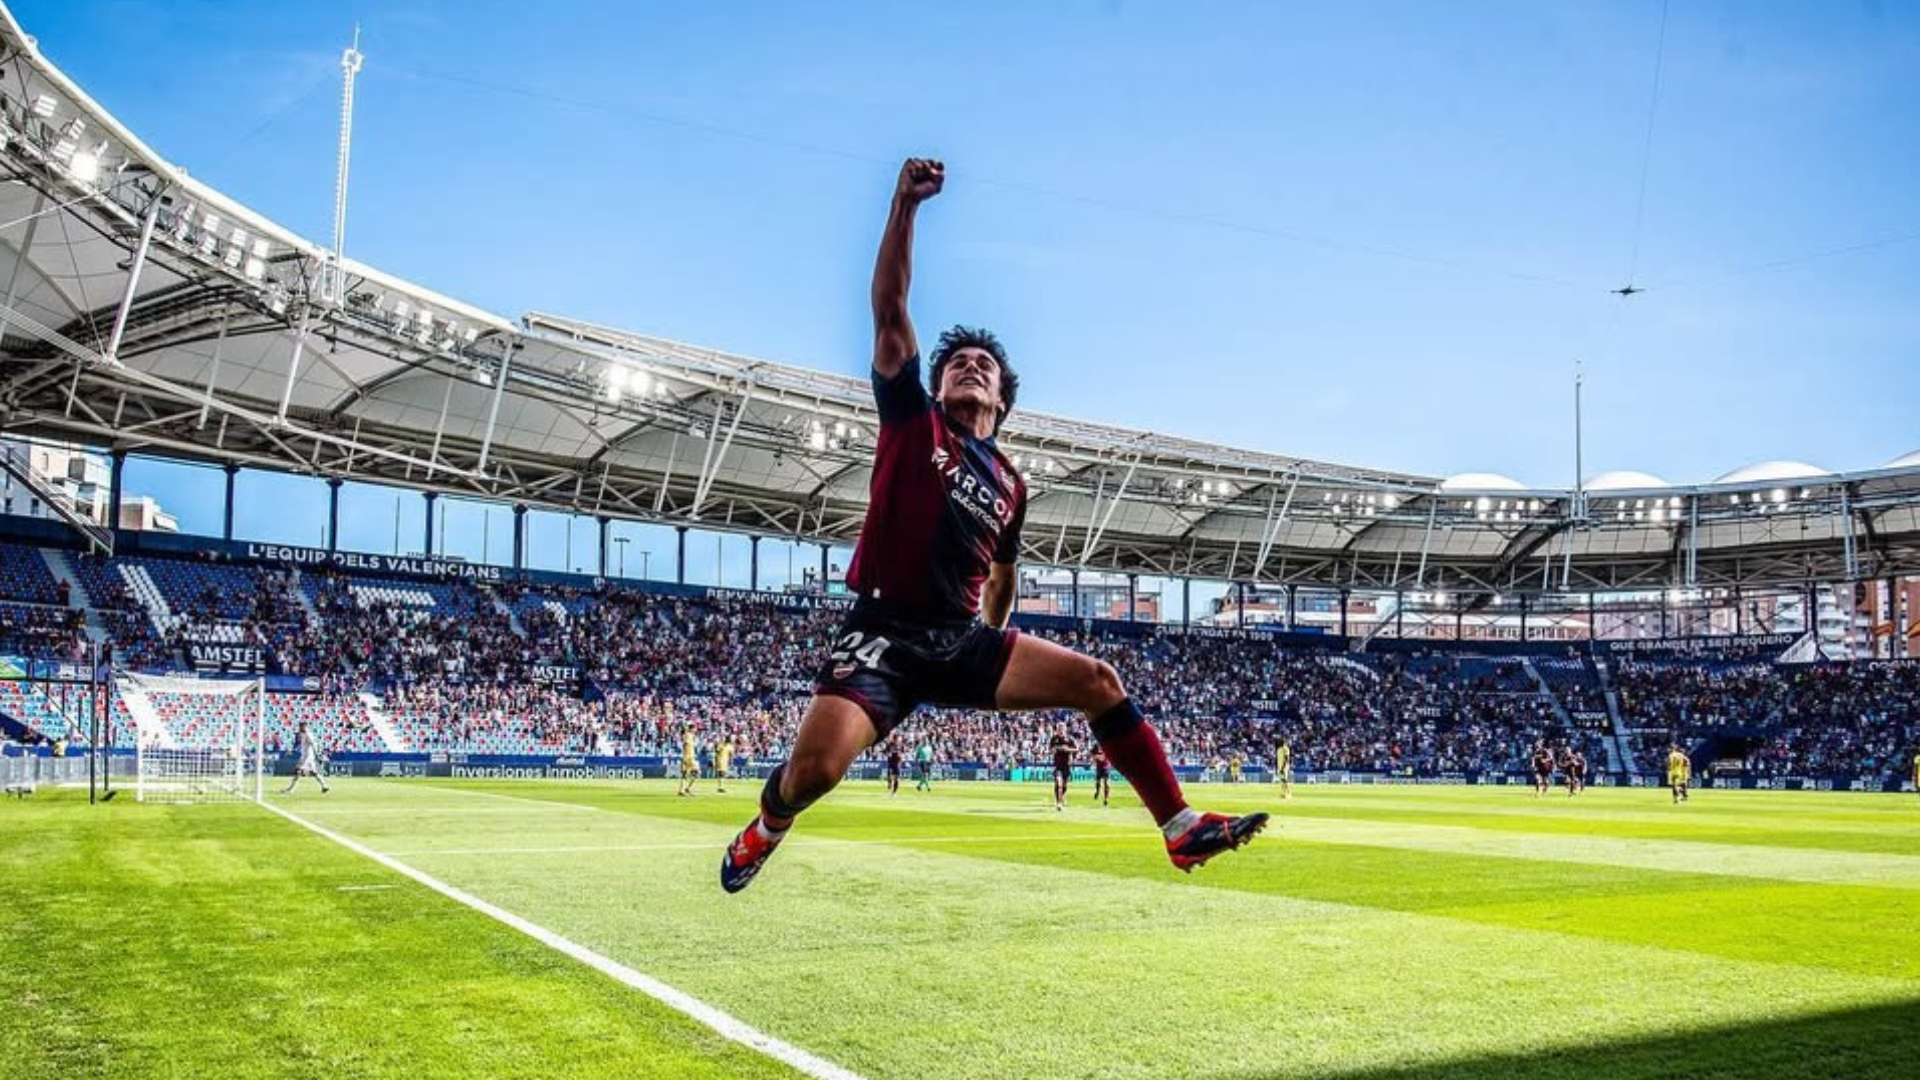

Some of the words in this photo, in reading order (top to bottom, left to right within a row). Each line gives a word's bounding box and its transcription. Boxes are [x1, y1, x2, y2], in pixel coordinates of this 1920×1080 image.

[249, 543, 327, 563] L'EQUIP
[333, 553, 380, 569] DELS
[387, 558, 500, 579] VALENCIANS
[191, 645, 265, 663] AMSTEL
[831, 631, 890, 669] 24
[1610, 641, 1636, 651] QUE
[1707, 637, 1731, 648] SER
